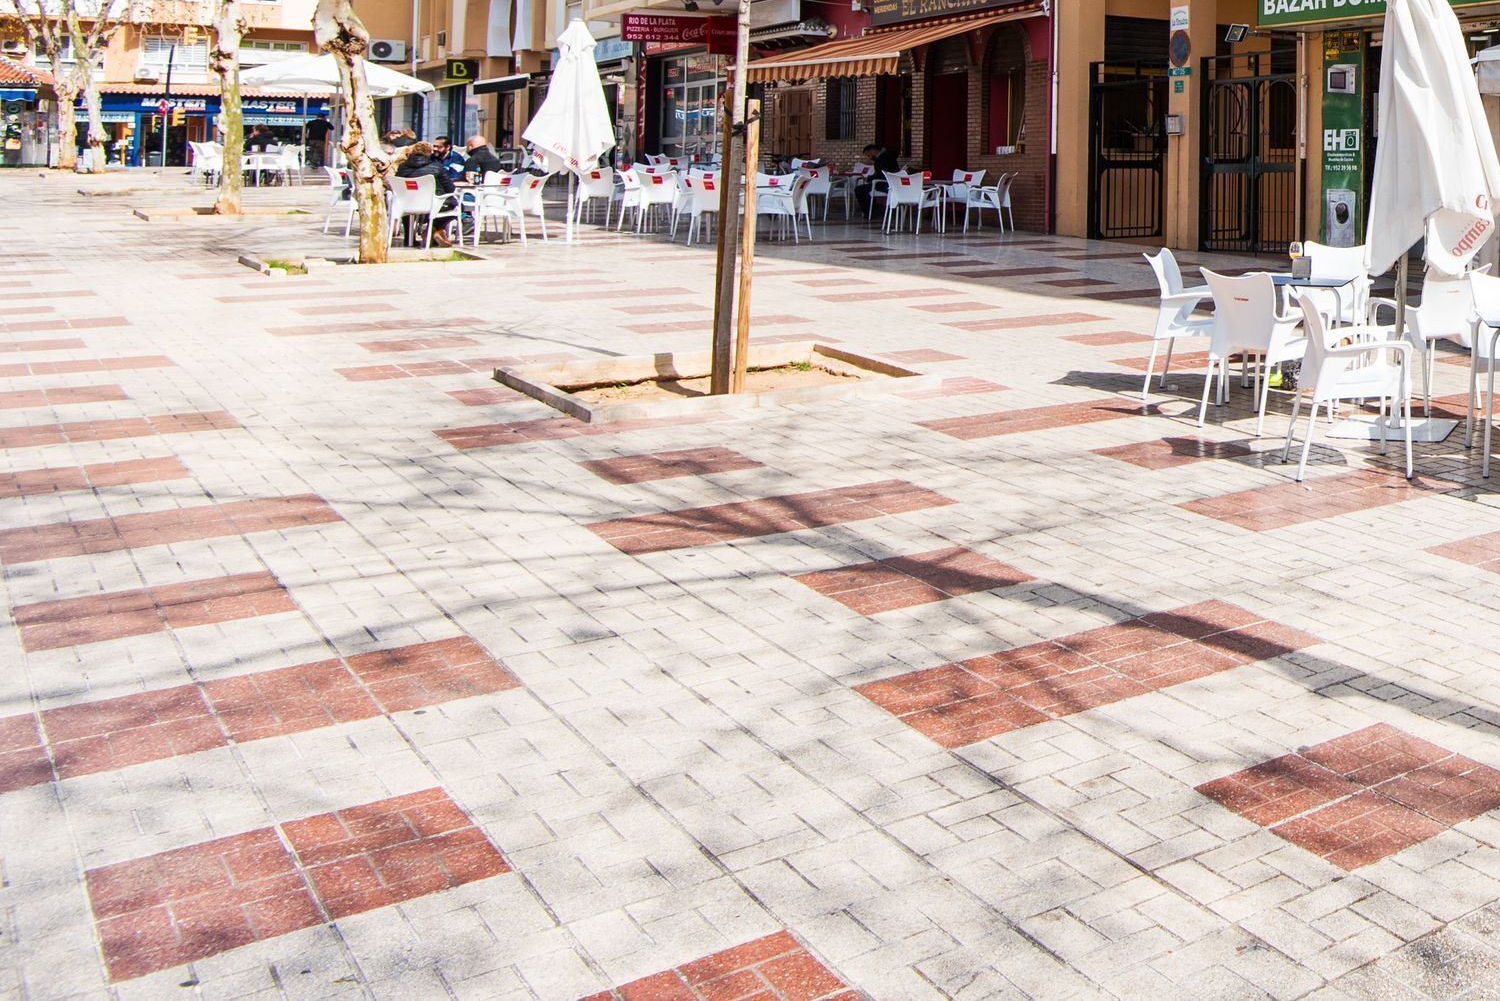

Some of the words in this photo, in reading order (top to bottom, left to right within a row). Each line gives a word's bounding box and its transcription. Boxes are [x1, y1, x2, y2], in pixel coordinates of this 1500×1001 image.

[628, 17, 639, 25] RIO
[640, 17, 648, 25] DE
[650, 17, 657, 25] LA
[658, 17, 676, 25] PLATA
